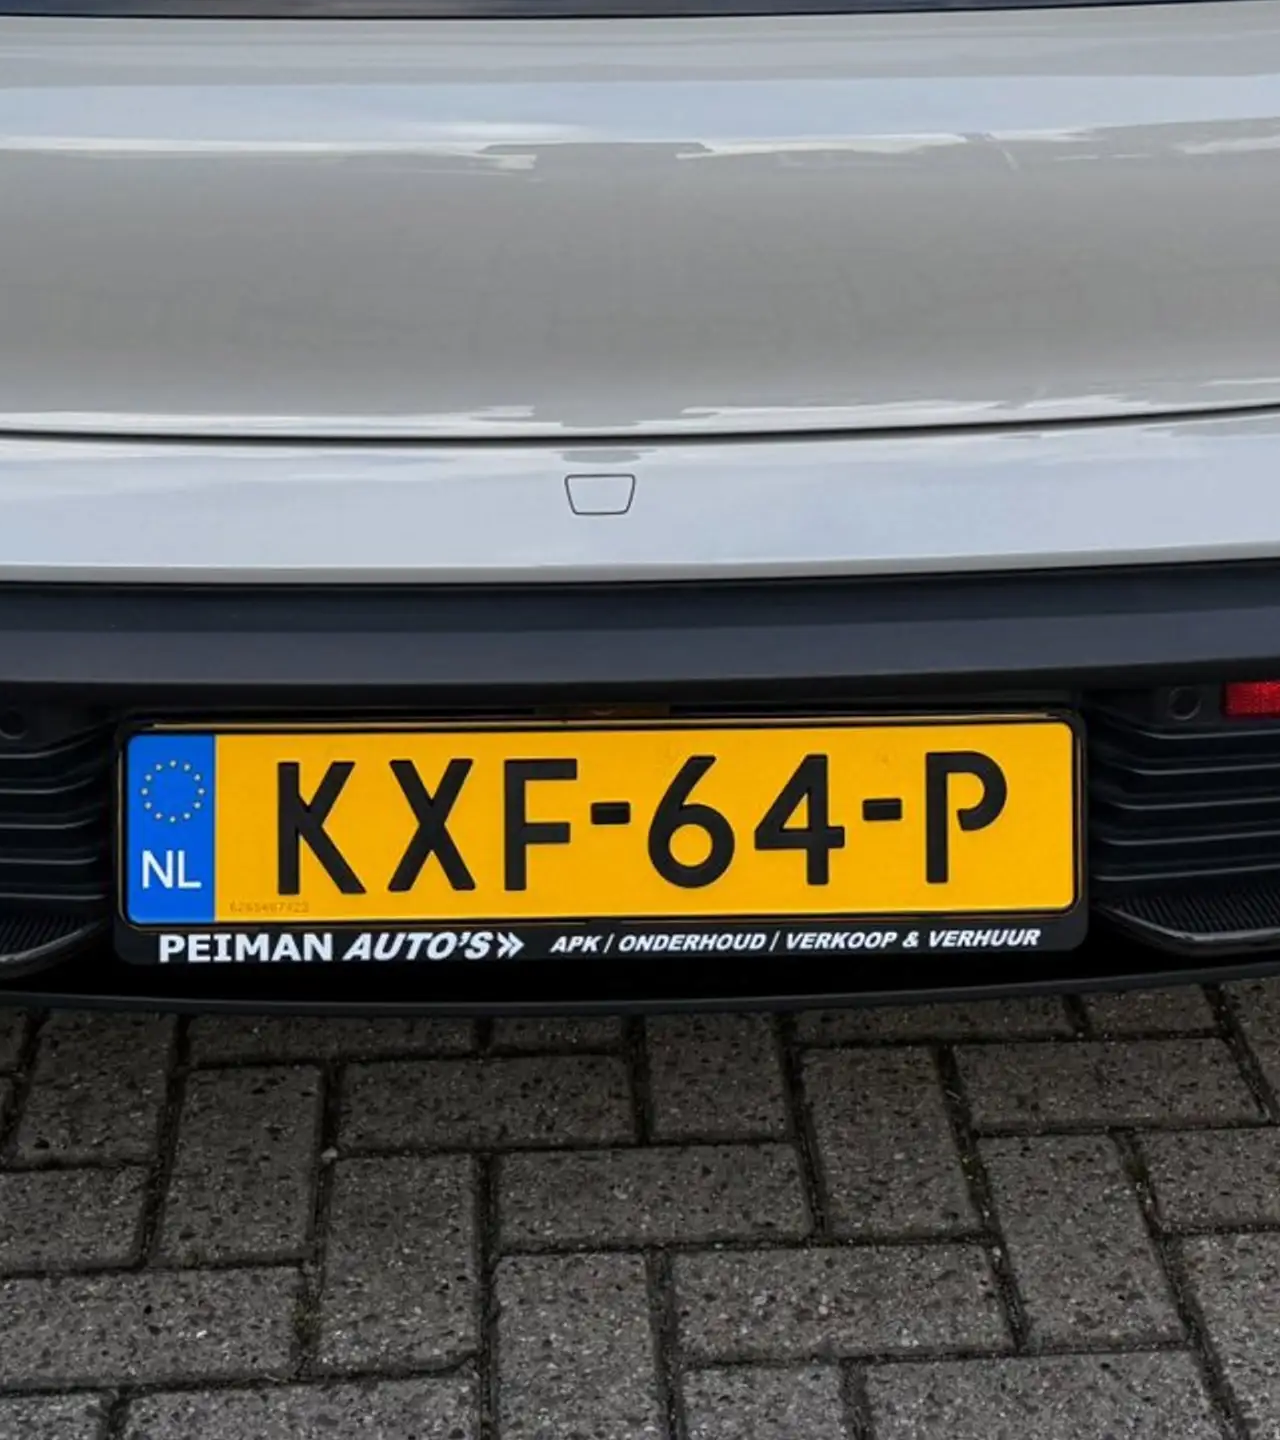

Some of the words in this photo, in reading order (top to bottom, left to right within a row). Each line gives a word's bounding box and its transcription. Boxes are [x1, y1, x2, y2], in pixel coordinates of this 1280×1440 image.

[276, 749, 1008, 896] KXF-64-P
[141, 849, 202, 889] NL
[159, 933, 334, 963] PEIMAN
[342, 931, 495, 961] AUTO'S
[550, 935, 603, 953] APK
[619, 933, 766, 953] ONDERHOUD
[786, 931, 898, 950] VERKOOP
[903, 931, 920, 947] &
[928, 929, 1042, 948] VERHUUR
